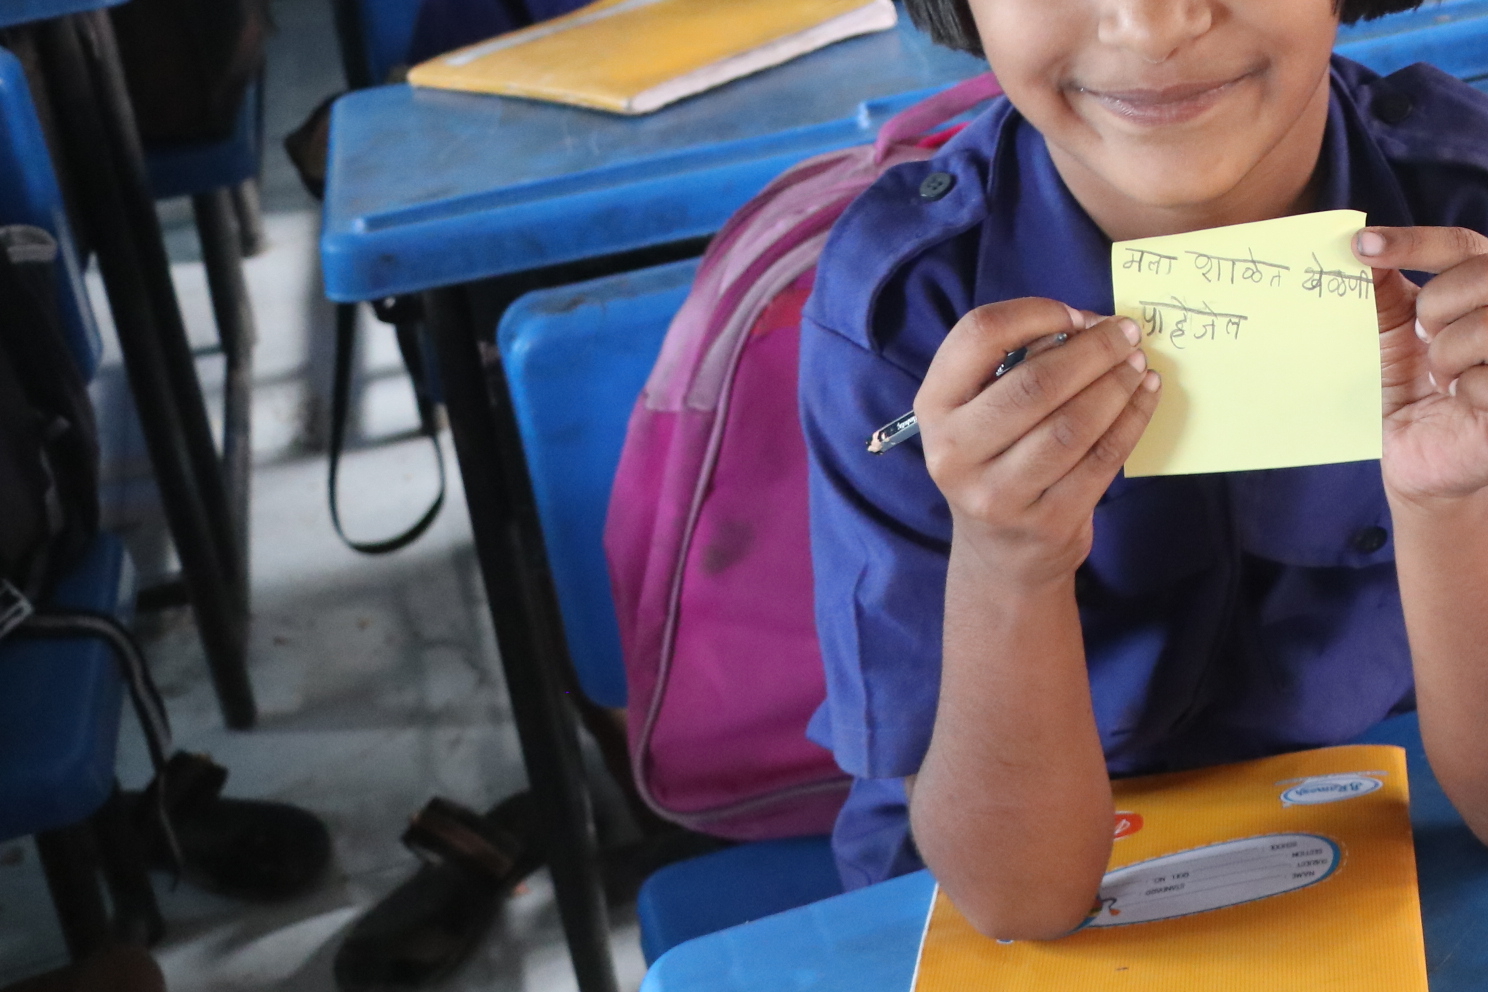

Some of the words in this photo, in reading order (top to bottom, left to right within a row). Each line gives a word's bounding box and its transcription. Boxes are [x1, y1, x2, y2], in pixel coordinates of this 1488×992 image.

[1122, 247, 1178, 276] मला
[1301, 251, 1374, 300] खेळणी
[1292, 870, 1315, 879] NAME
